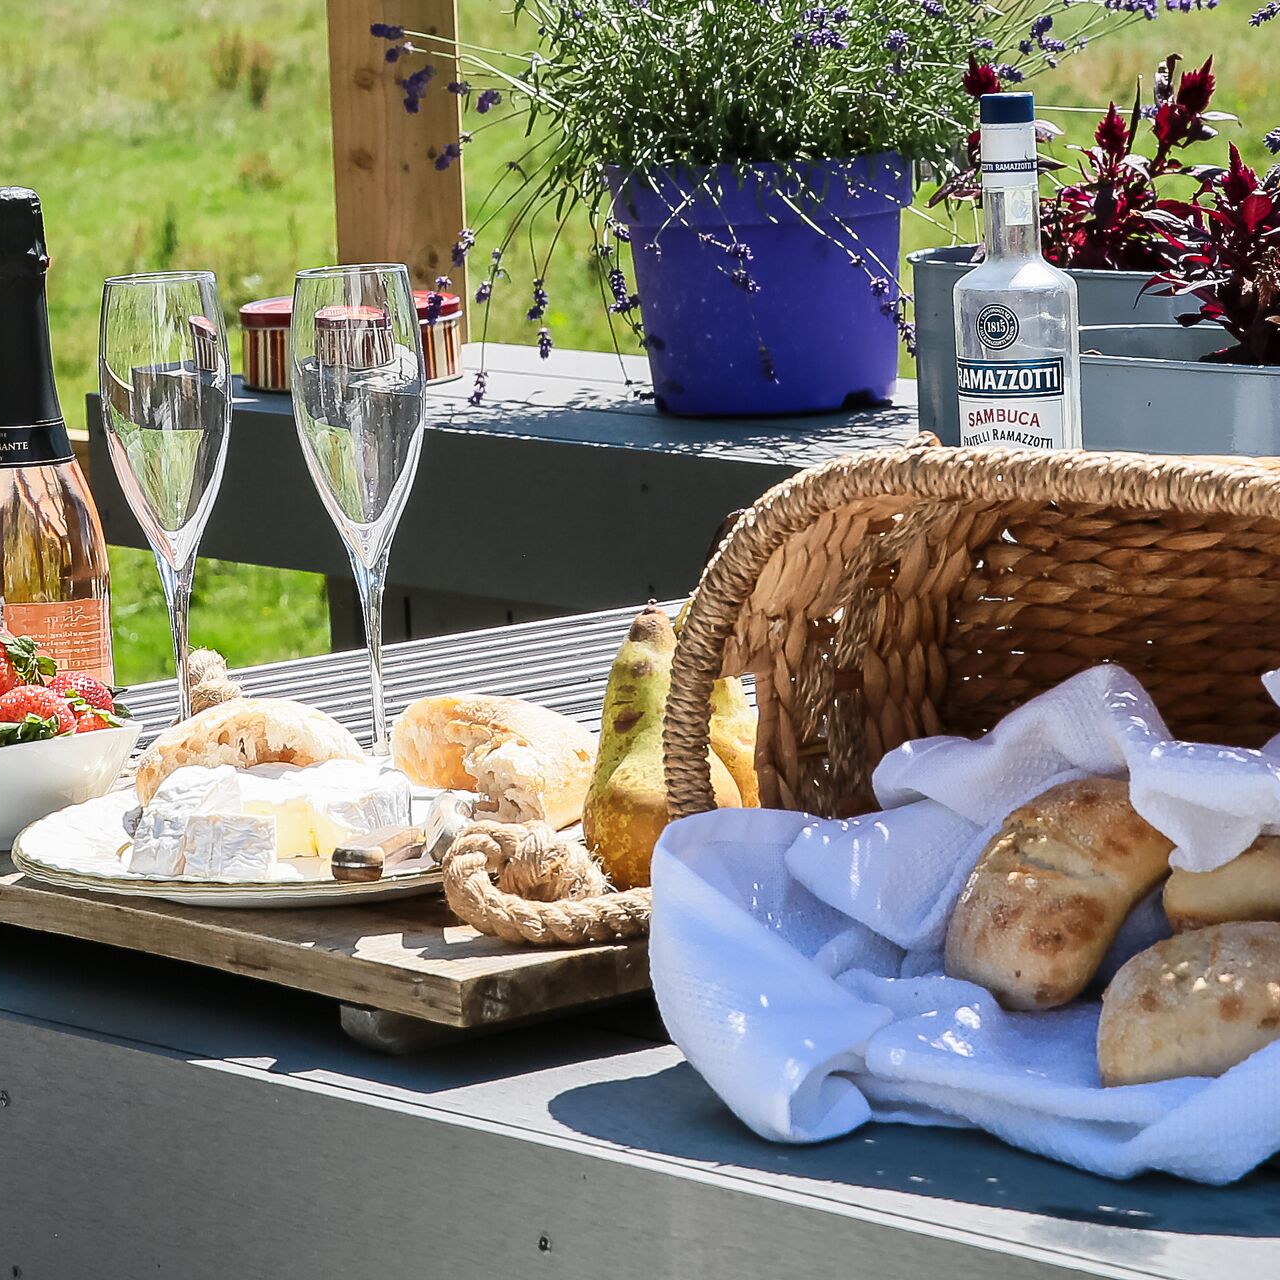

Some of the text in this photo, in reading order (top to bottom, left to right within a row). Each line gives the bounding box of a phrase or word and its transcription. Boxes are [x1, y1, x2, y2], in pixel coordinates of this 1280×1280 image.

[995, 162, 1032, 171] RAMAZZOTTI
[986, 320, 1006, 333] 1815
[958, 366, 1058, 390] RAMAZZOTTI
[968, 408, 1041, 428] SAMBUCA
[992, 428, 1053, 449] RAMAZZOTTI
